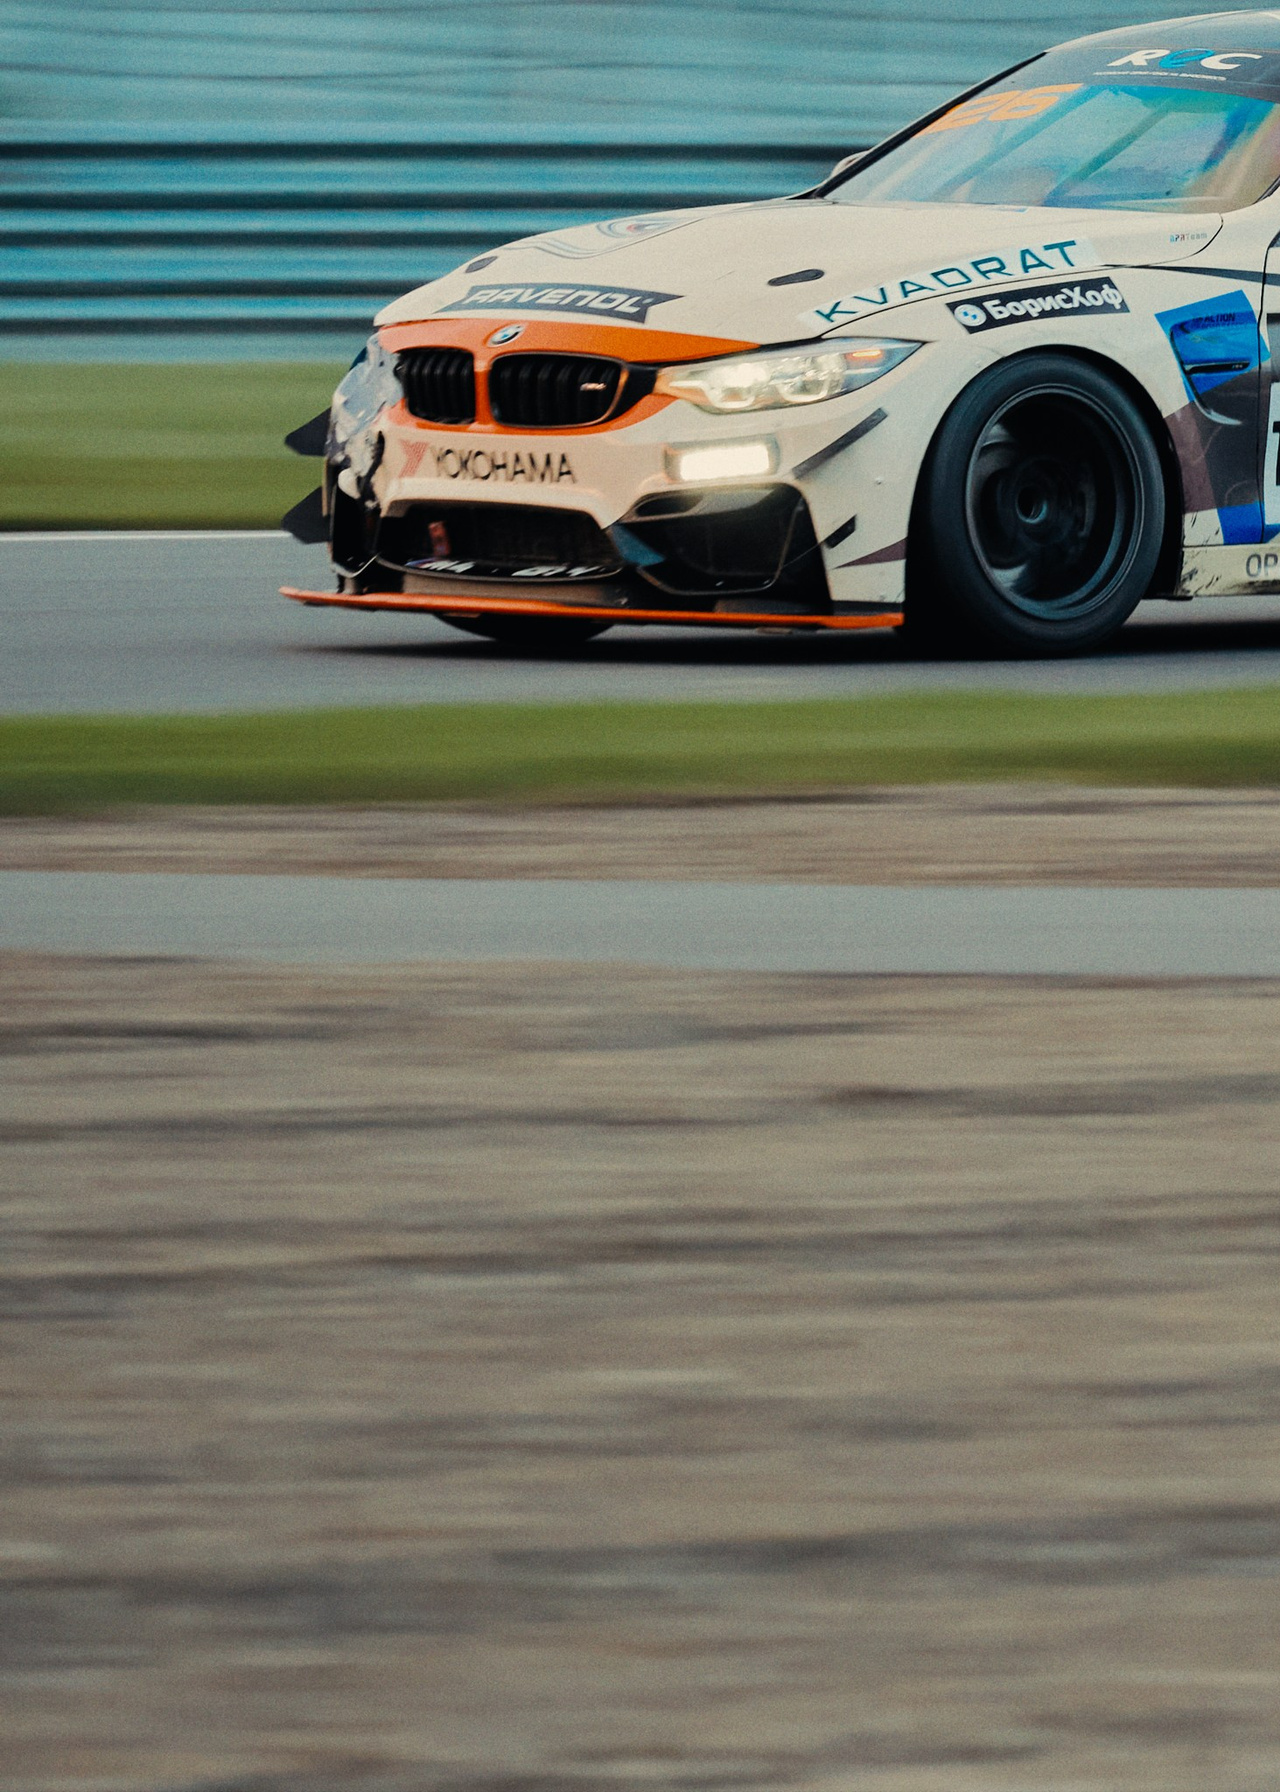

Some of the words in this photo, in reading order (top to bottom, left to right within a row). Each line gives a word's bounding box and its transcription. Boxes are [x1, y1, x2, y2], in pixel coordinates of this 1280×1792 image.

[814, 240, 1077, 323] KVADRAT
[461, 288, 647, 314] RAVENOL
[982, 284, 1124, 320] БорисХоф
[429, 445, 577, 484] YOKOHAMA
